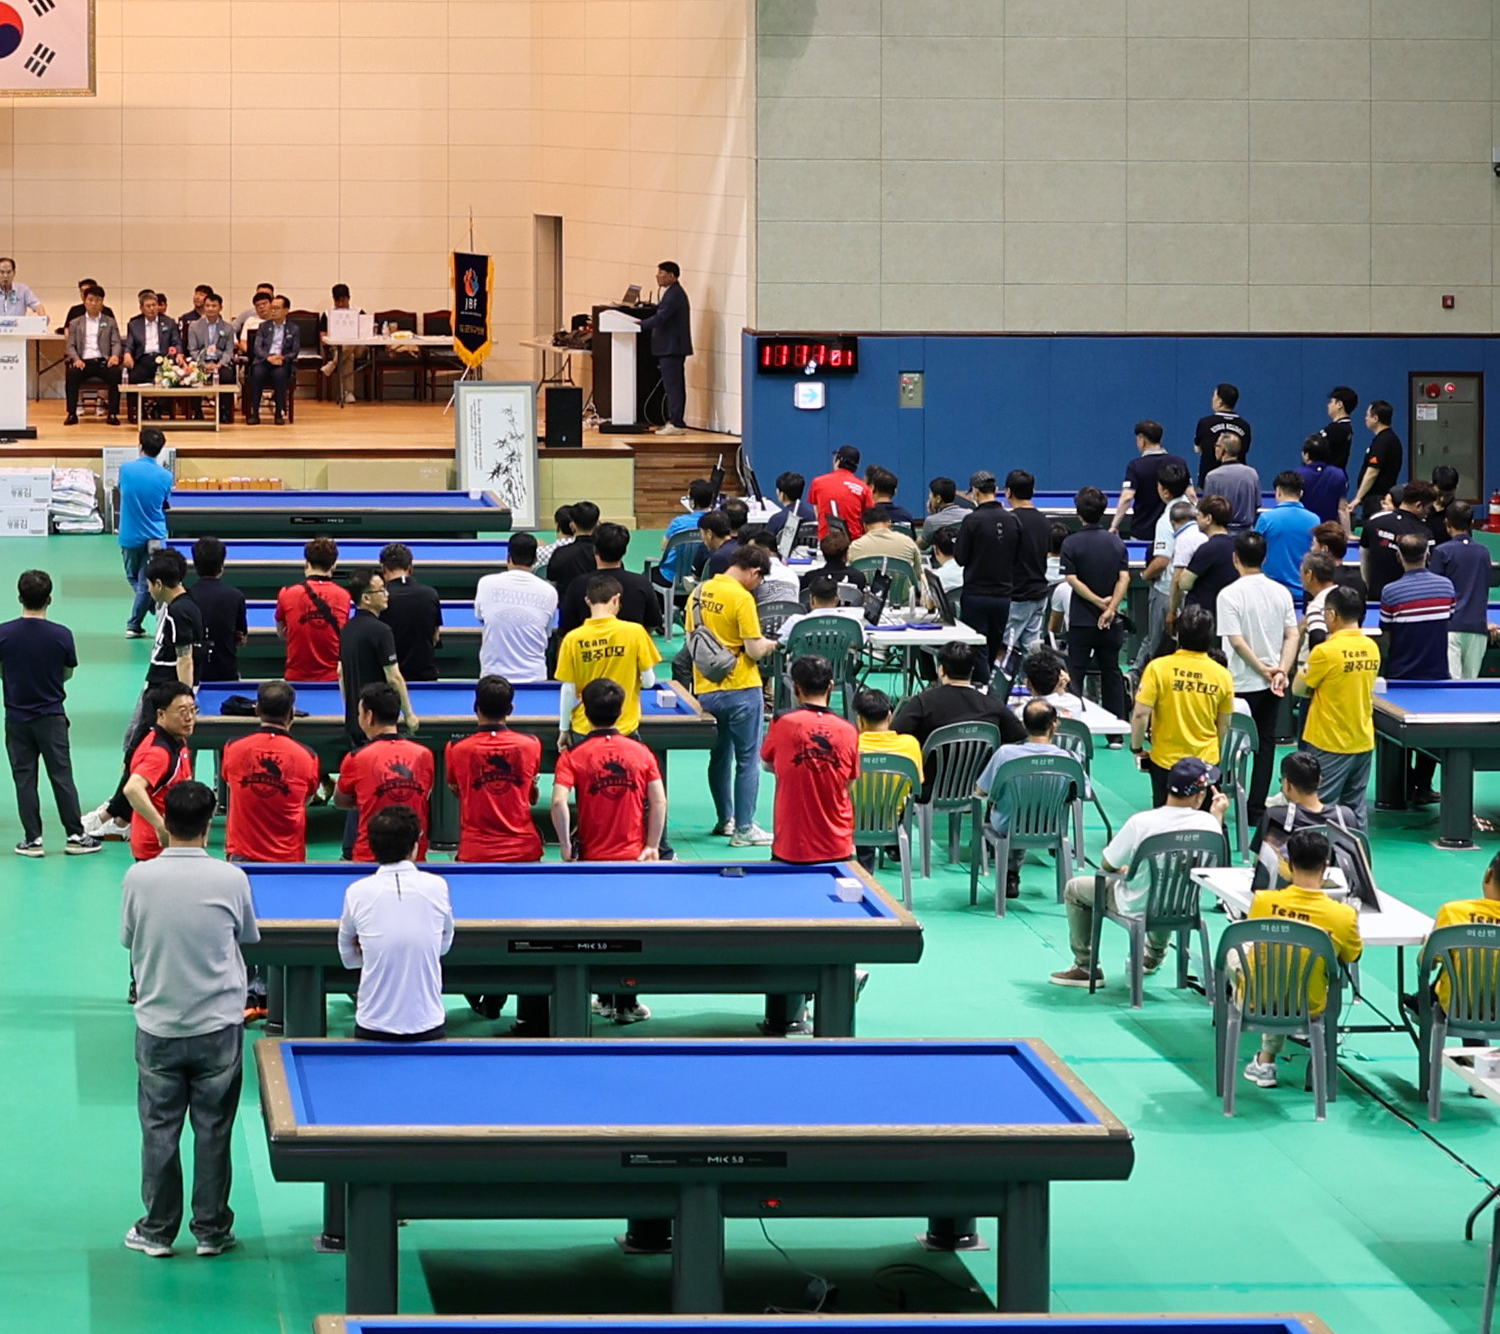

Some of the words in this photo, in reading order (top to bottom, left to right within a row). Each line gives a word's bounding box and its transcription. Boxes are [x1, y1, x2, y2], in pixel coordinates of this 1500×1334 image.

[578, 638, 608, 649] Team
[1342, 649, 1368, 659] Team
[1173, 667, 1203, 679] Team
[1270, 903, 1311, 922] Team
